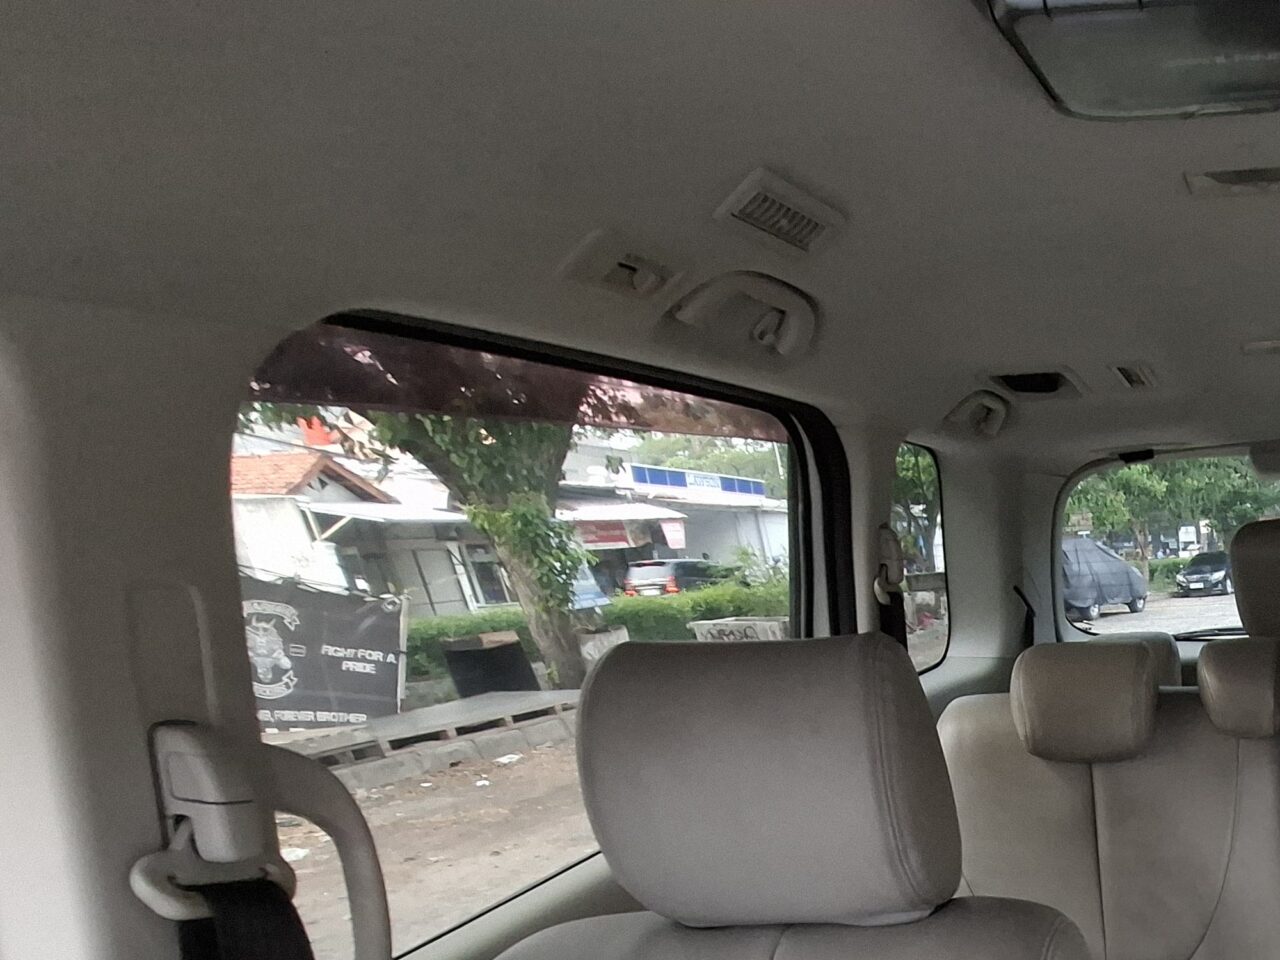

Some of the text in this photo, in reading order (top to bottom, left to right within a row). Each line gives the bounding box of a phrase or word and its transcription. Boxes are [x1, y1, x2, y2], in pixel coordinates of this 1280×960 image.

[321, 644, 398, 664] FIGHT FOR A
[341, 660, 377, 674] PRIDE
[316, 711, 367, 723] BROTHER
